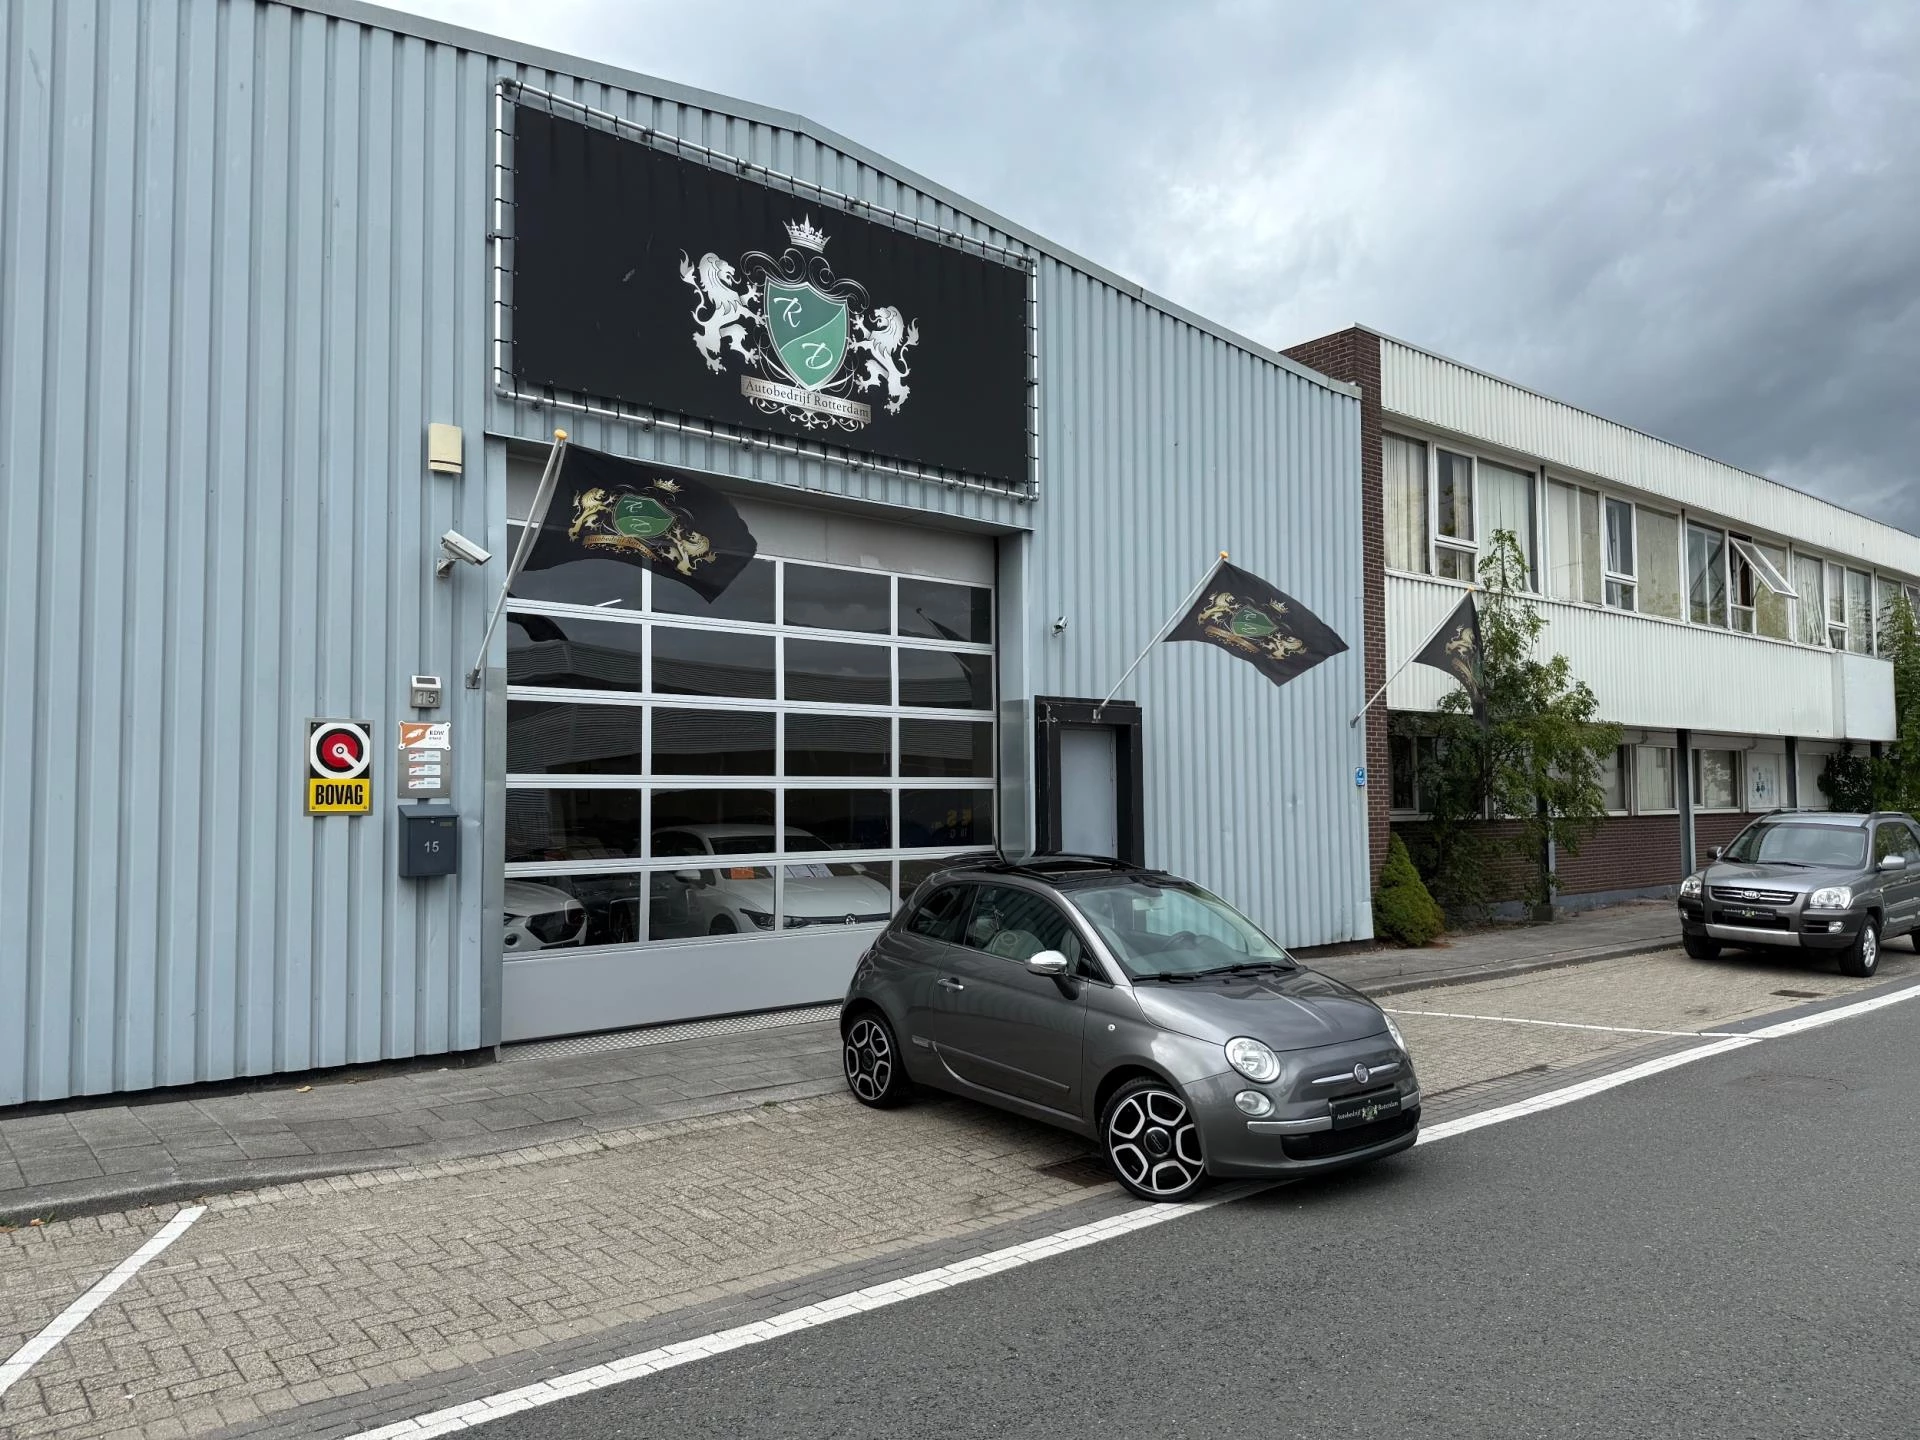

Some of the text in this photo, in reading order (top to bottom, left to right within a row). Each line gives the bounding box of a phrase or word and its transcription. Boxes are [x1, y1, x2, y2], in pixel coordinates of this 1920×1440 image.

[774, 297, 803, 328] R
[802, 342, 833, 370] D
[746, 380, 869, 418] Autobedrijf Rotterdam
[419, 691, 436, 704] 15
[315, 784, 364, 805] BOVAG
[424, 841, 440, 854] 15
